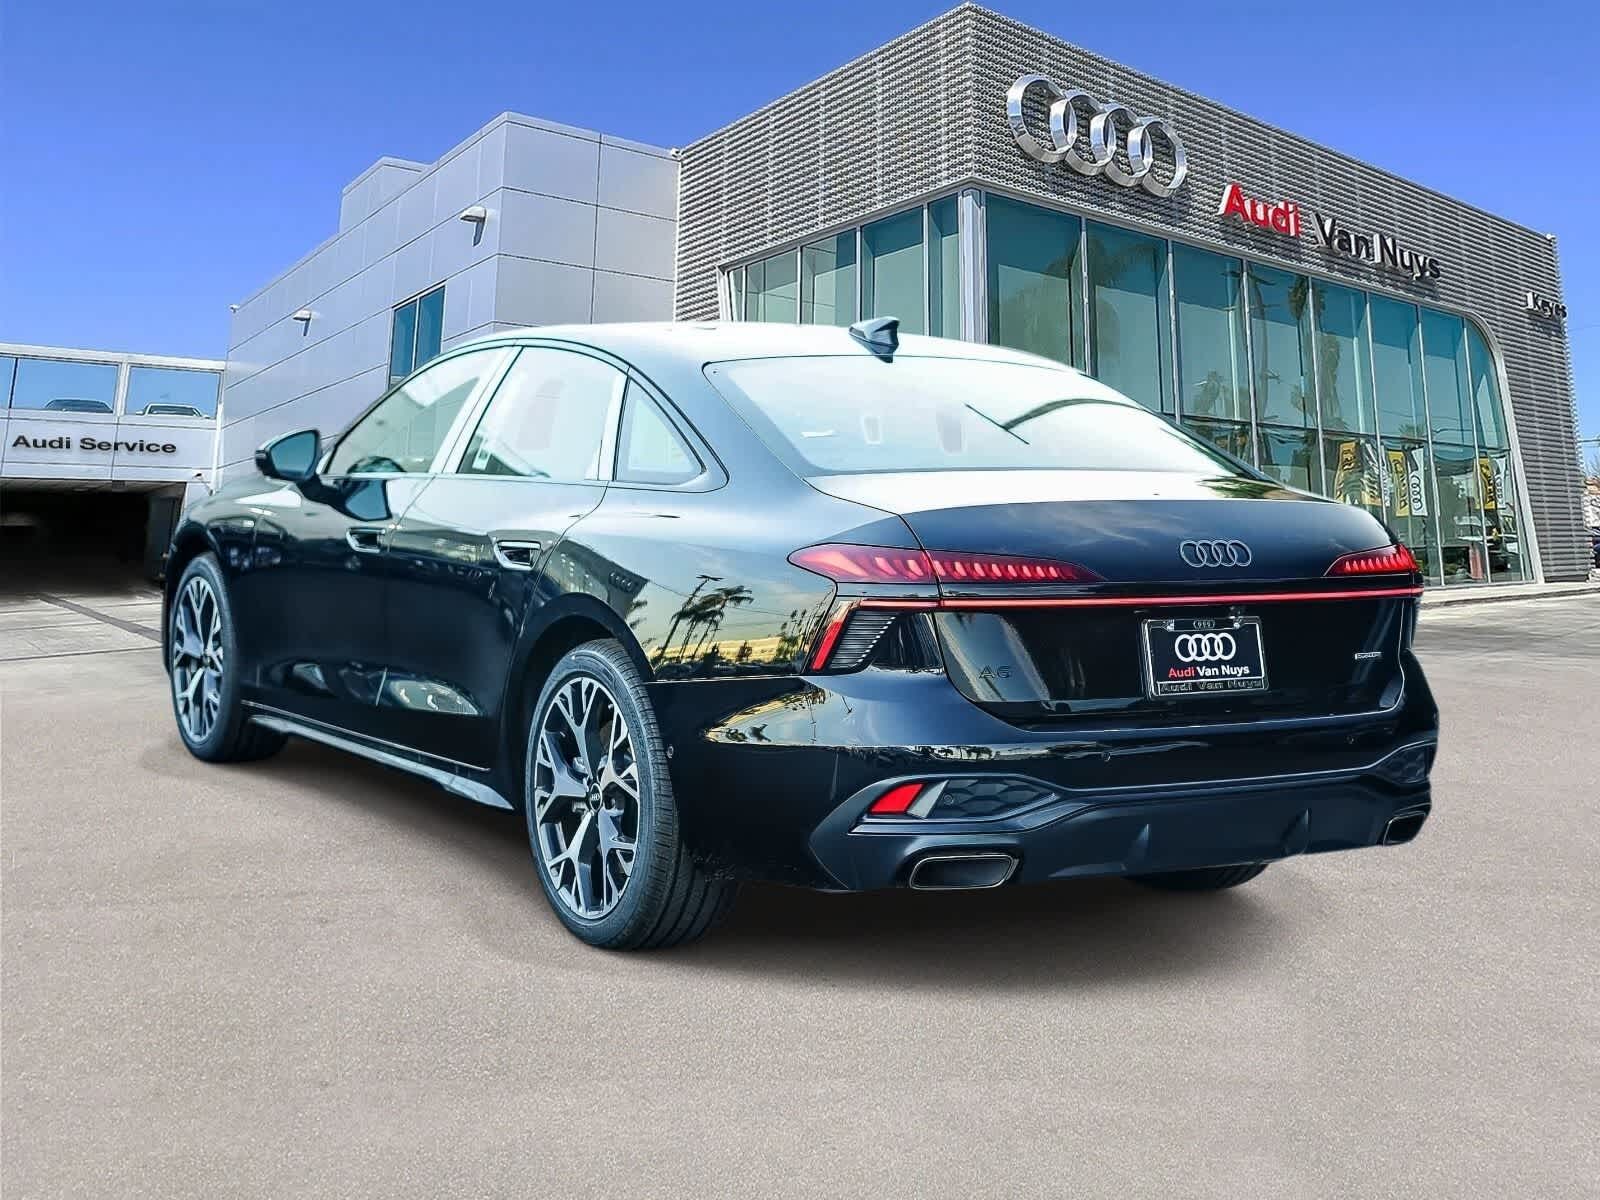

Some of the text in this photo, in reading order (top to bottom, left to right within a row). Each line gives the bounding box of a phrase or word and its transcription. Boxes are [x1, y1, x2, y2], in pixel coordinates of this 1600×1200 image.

[1218, 182, 1441, 281] Audi Van Nuys
[12, 435, 177, 454] Audi Service
[979, 664, 1010, 679] A6
[1168, 664, 1250, 678] Audi Van Nuys
[1160, 679, 1262, 693] Audi Van Nuys
